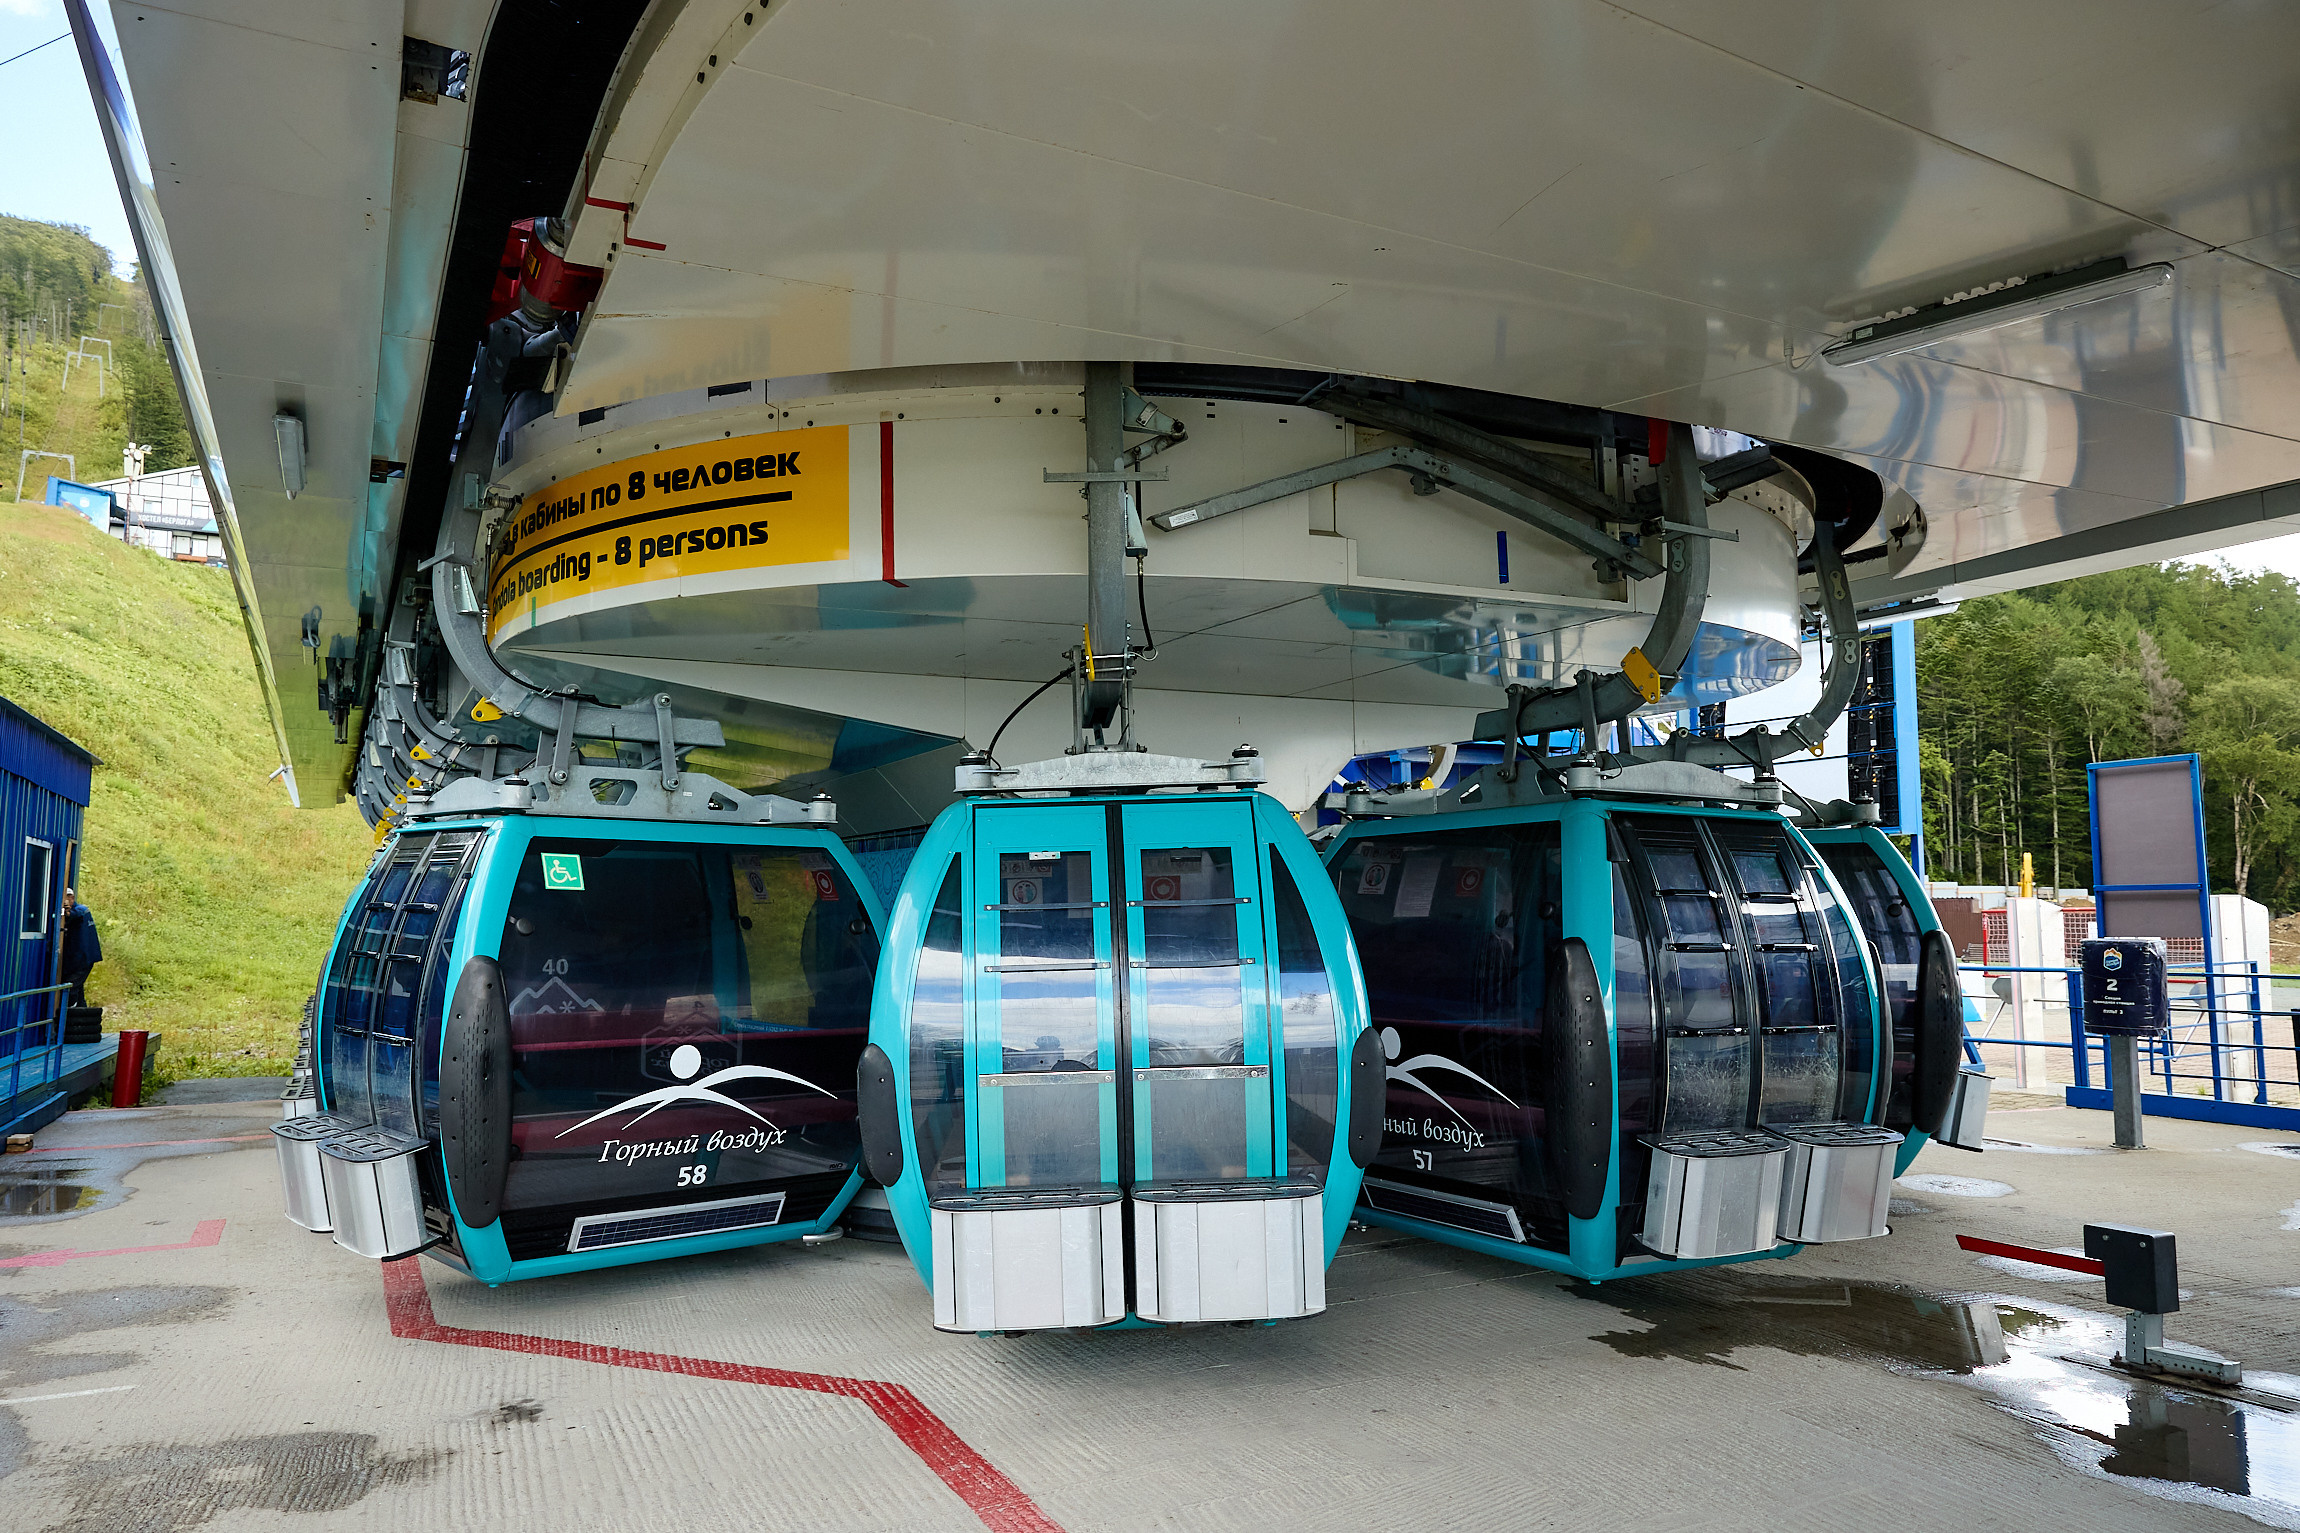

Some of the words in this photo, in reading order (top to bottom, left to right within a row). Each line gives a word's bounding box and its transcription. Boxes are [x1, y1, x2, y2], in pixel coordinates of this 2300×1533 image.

[520, 491, 586, 540] кабины
[591, 482, 621, 511] по
[627, 470, 646, 501] 8
[653, 451, 802, 494] человек
[138, 514, 161, 523] ХОСТЕЛ
[518, 551, 591, 598] boarding
[597, 553, 608, 564] -
[614, 536, 632, 566] 8
[639, 520, 769, 569] persons
[542, 958, 569, 975] 40
[2106, 978, 2118, 991] 2
[598, 1134, 700, 1167] Горный
[706, 1126, 787, 1154] воздух
[1382, 1117, 1419, 1136] ный
[1423, 1118, 1485, 1153] воздух
[1412, 1149, 1433, 1171] 57
[676, 1164, 708, 1187] 58
